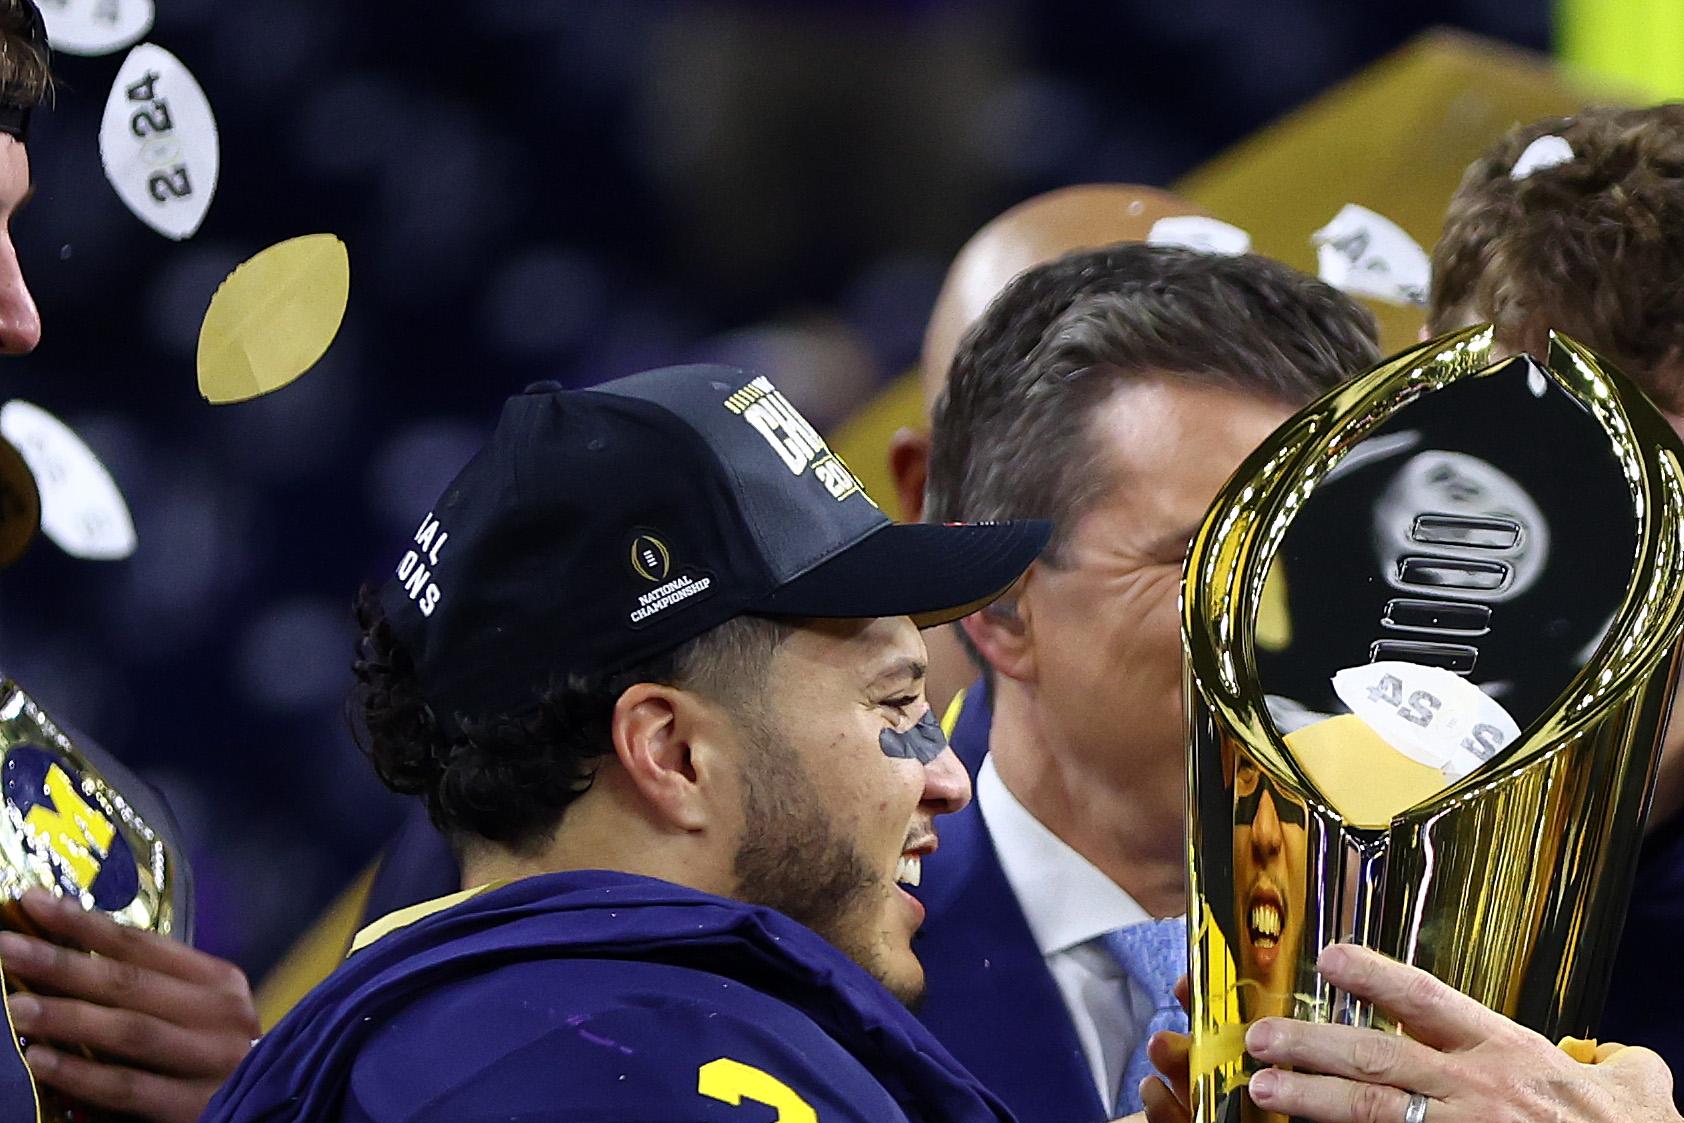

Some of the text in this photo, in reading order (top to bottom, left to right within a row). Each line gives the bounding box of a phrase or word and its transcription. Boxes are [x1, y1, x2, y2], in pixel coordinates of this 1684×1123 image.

[630, 577, 711, 623] CHAMPIONSHIP
[638, 575, 693, 607] NATIONAL
[23, 762, 117, 891] M
